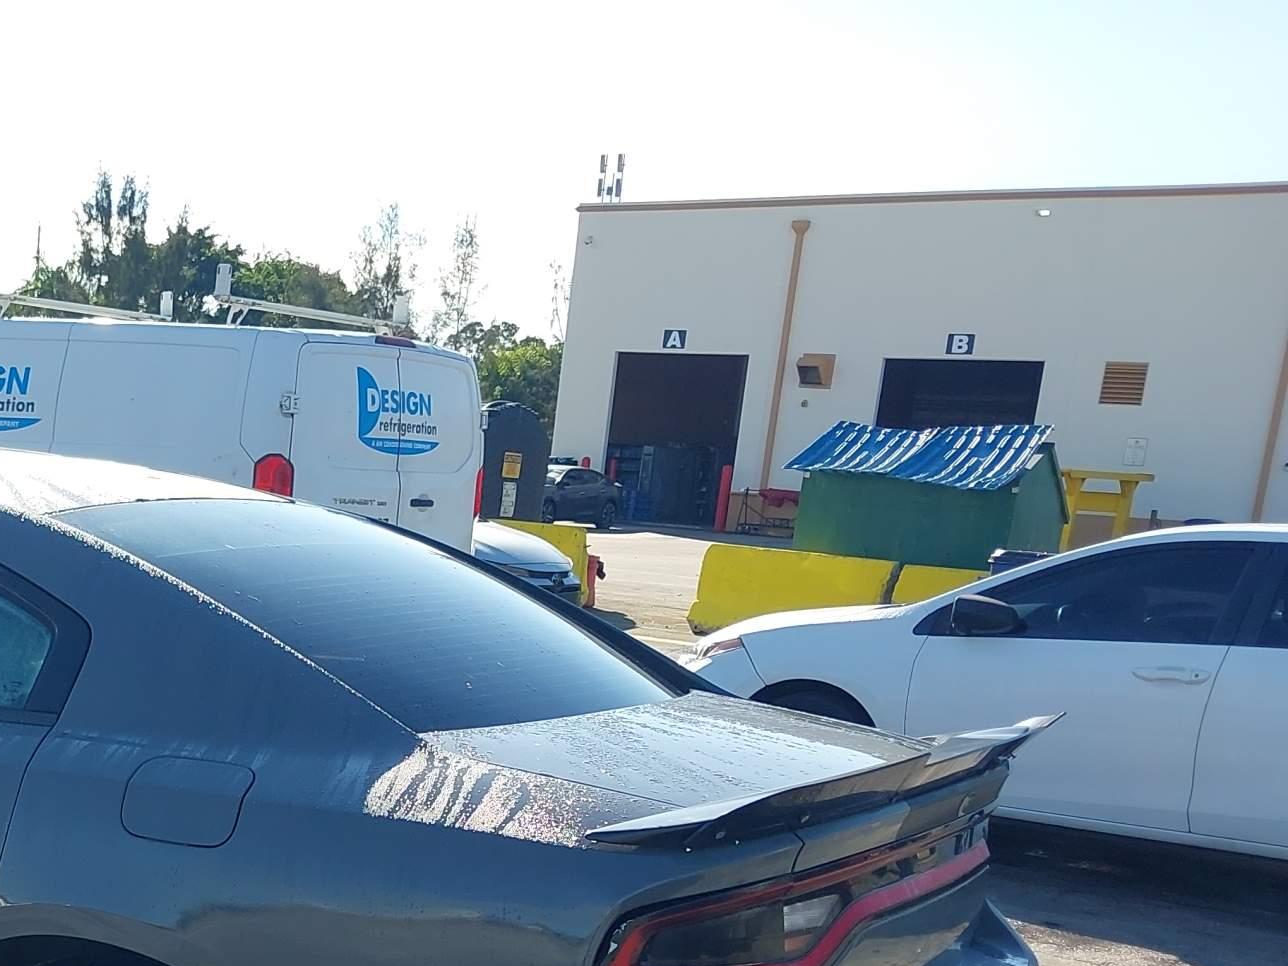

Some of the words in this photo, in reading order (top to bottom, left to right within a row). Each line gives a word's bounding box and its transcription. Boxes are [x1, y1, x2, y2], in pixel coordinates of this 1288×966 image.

[665, 330, 682, 348] A
[951, 335, 969, 354] B
[367, 388, 432, 416] DESIGN
[379, 417, 437, 436] refrigeration
